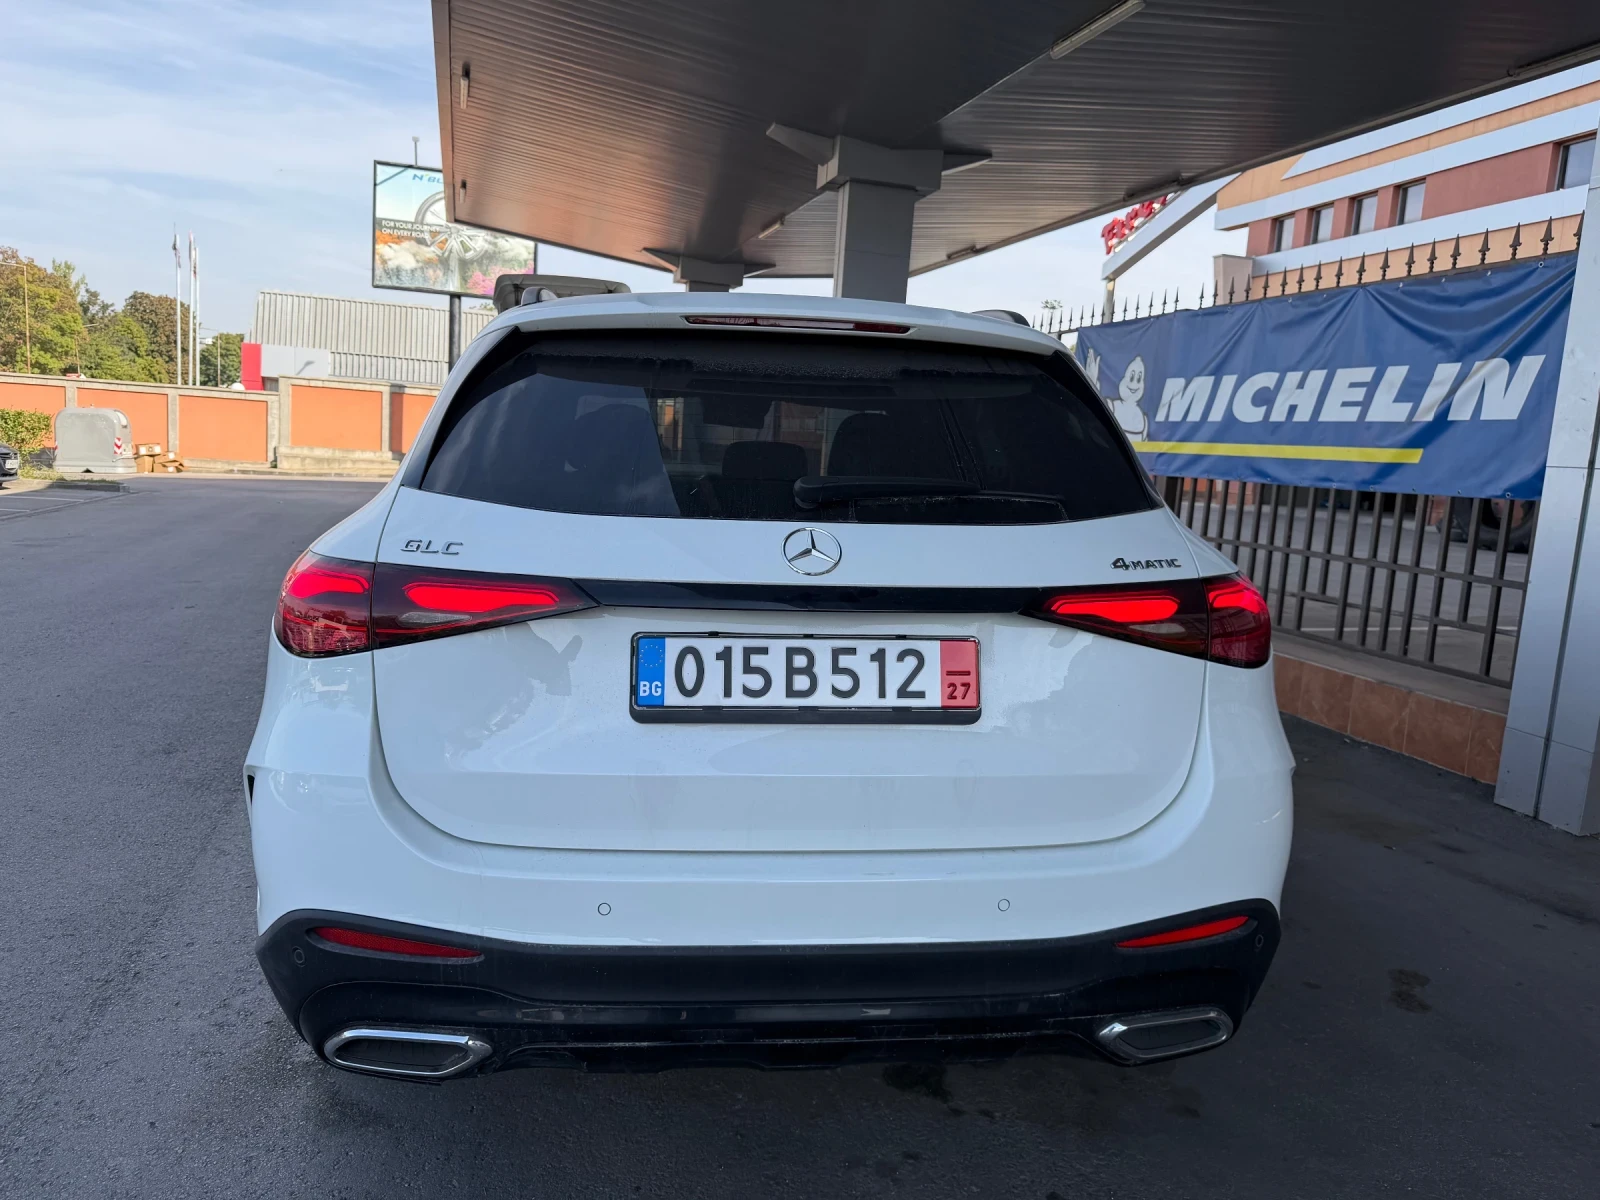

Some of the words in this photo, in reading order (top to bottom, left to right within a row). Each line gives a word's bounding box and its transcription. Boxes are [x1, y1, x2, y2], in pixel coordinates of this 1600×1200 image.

[394, 229, 411, 237] EVERY
[412, 231, 428, 239] ROAD
[395, 221, 412, 230] YOUR
[413, 224, 439, 233] JOURNEY
[1155, 355, 1546, 423] MICHELIN
[400, 539, 463, 556] GLC
[1110, 557, 1181, 570] 4MATIC
[639, 681, 662, 697] BG
[674, 645, 926, 700] 015B512
[947, 682, 971, 700] 27
